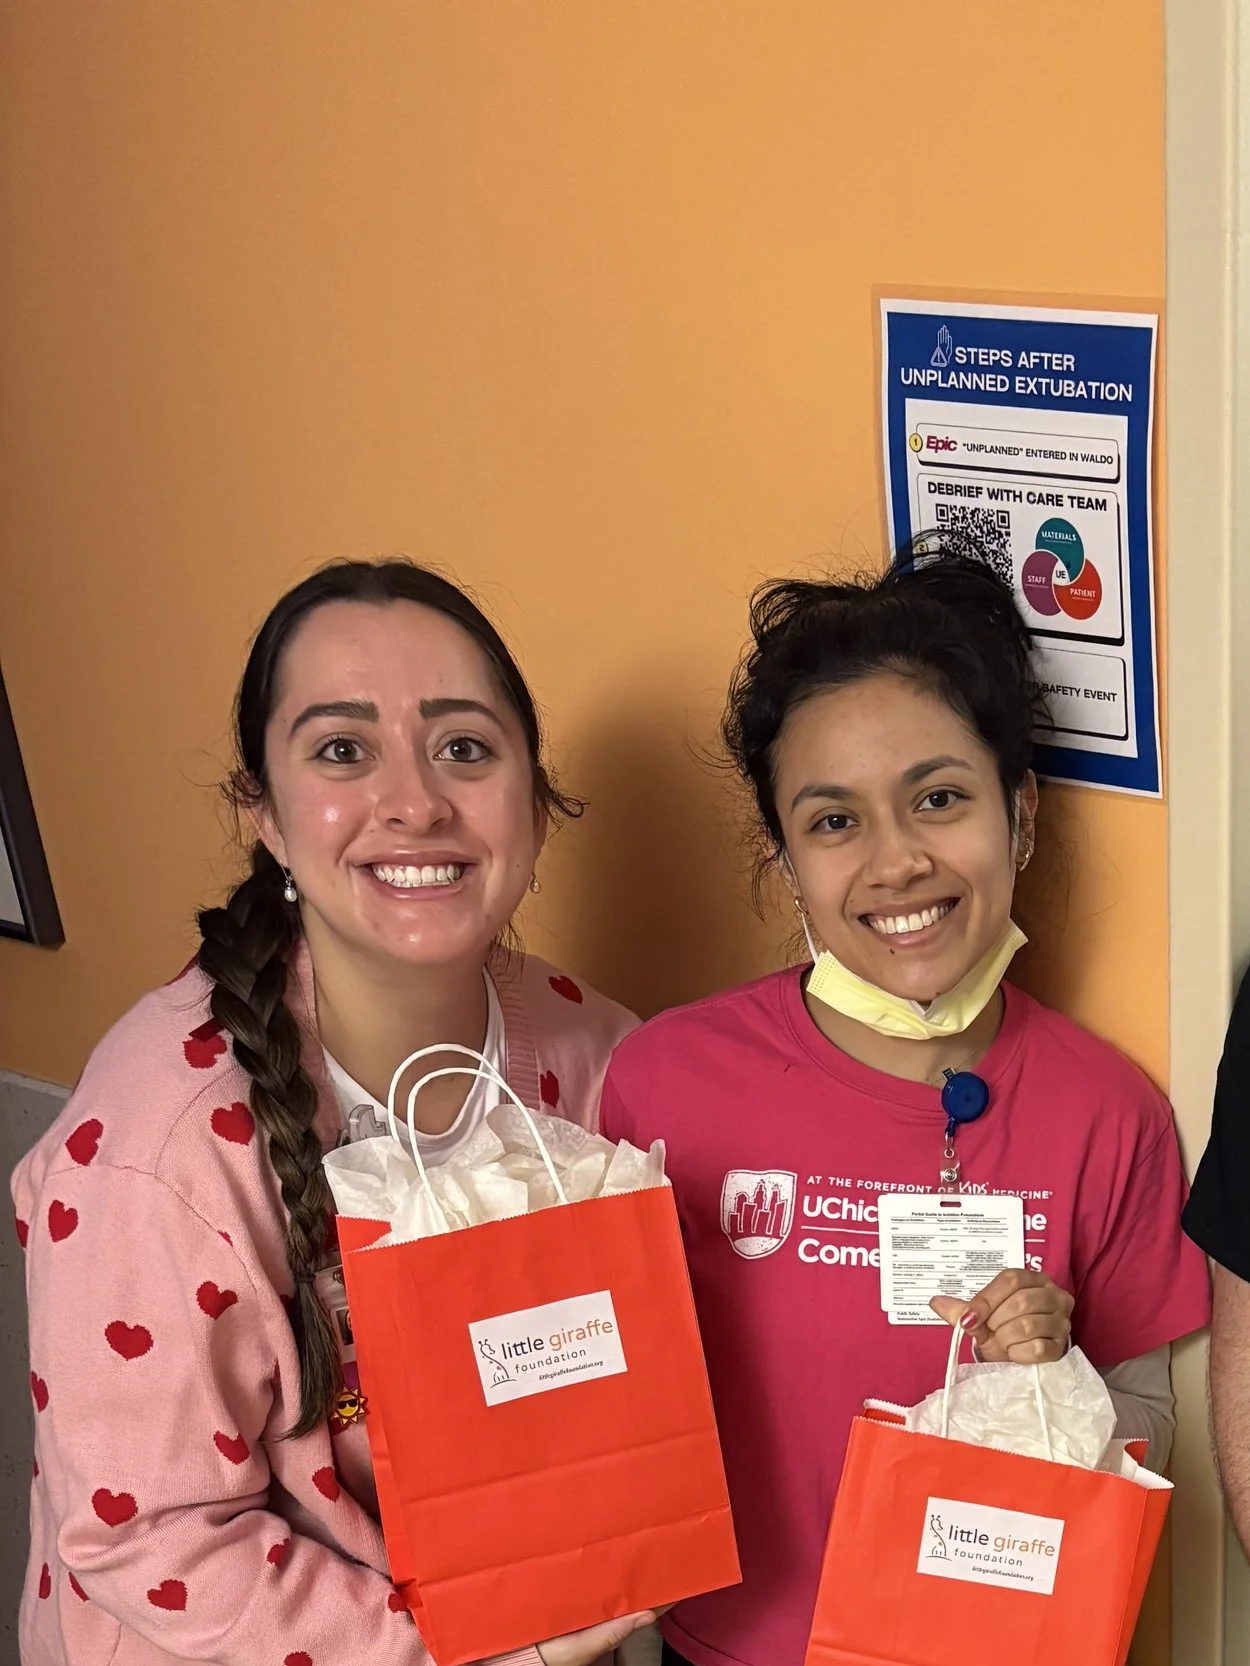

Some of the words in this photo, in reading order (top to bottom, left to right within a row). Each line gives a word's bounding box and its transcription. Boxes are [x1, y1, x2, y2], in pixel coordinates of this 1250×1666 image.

[954, 346, 1012, 367] STEPS
[1018, 352, 1075, 371] AFTER
[901, 367, 1009, 392] UNPLANNED
[1015, 376, 1132, 401] EXTUBATION
[926, 435, 958, 453] Epic
[1026, 448, 1067, 461] ENTERED
[1069, 452, 1078, 462] IN
[1081, 453, 1113, 465] WALDO
[927, 481, 983, 499] DEBRIEF
[987, 487, 1023, 503] WITH
[1026, 491, 1064, 507] CARE
[1067, 496, 1107, 512] TEAM
[1041, 530, 1077, 542] MATERIALS
[1027, 574, 1046, 585] STAFF
[1055, 569, 1066, 580] UE
[1069, 587, 1096, 598] PATIENT
[1042, 683, 1081, 697] SAFETY
[1083, 689, 1117, 702] EVENT
[807, 1175, 822, 1185] AT
[829, 1177, 852, 1188] THE
[857, 1179, 933, 1193] FOREFRONT
[803, 1195, 879, 1223] UChic
[798, 1238, 881, 1268] Come
[502, 1337, 545, 1360] little
[549, 1319, 614, 1352] giraffe
[515, 1349, 587, 1374] foundation
[948, 1524, 989, 1546] little
[993, 1534, 1055, 1557] giraffe
[954, 1548, 1023, 1567] foundation
